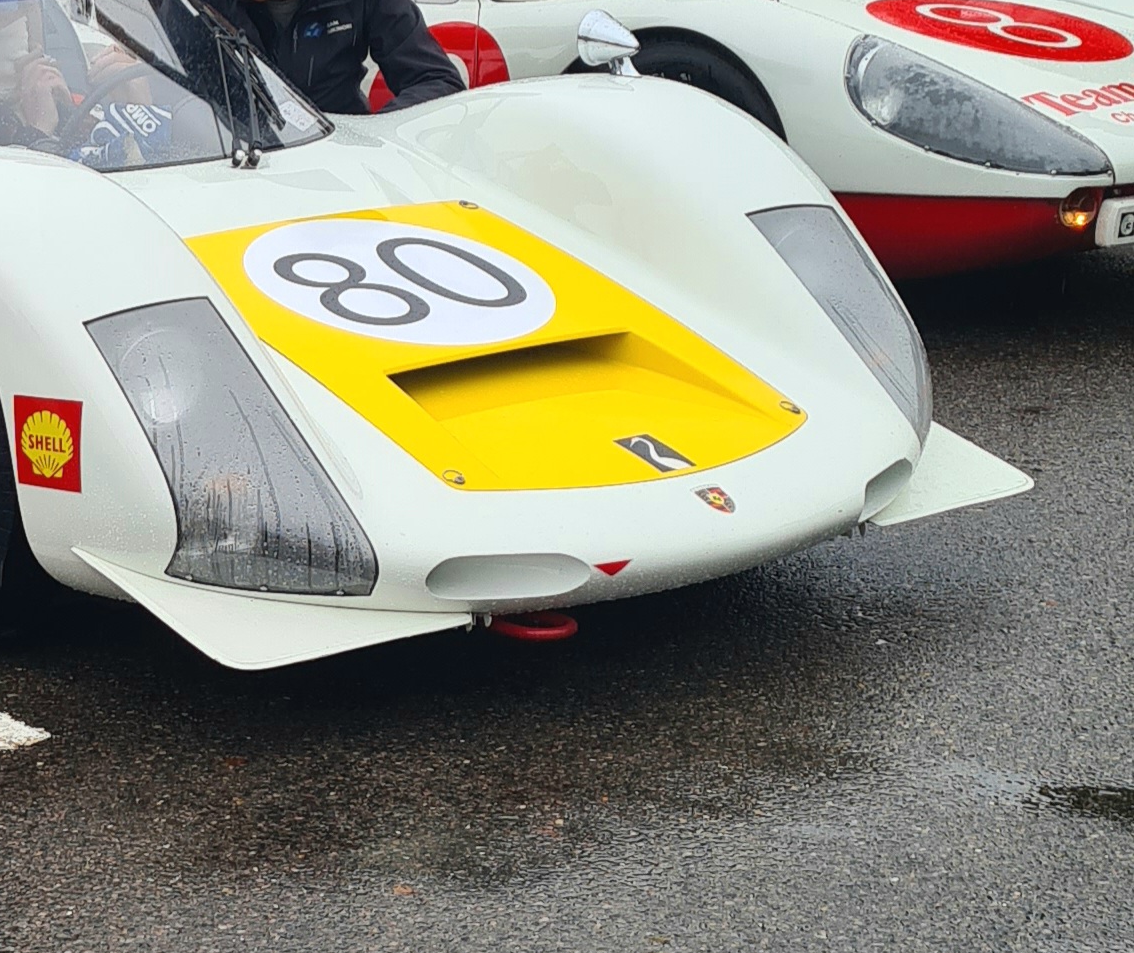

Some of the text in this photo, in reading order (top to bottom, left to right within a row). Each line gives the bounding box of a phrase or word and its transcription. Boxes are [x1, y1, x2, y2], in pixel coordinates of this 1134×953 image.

[1020, 82, 1134, 116] Team
[126, 103, 157, 133] OMP
[273, 236, 528, 326] 80
[28, 434, 66, 454] SHELL
